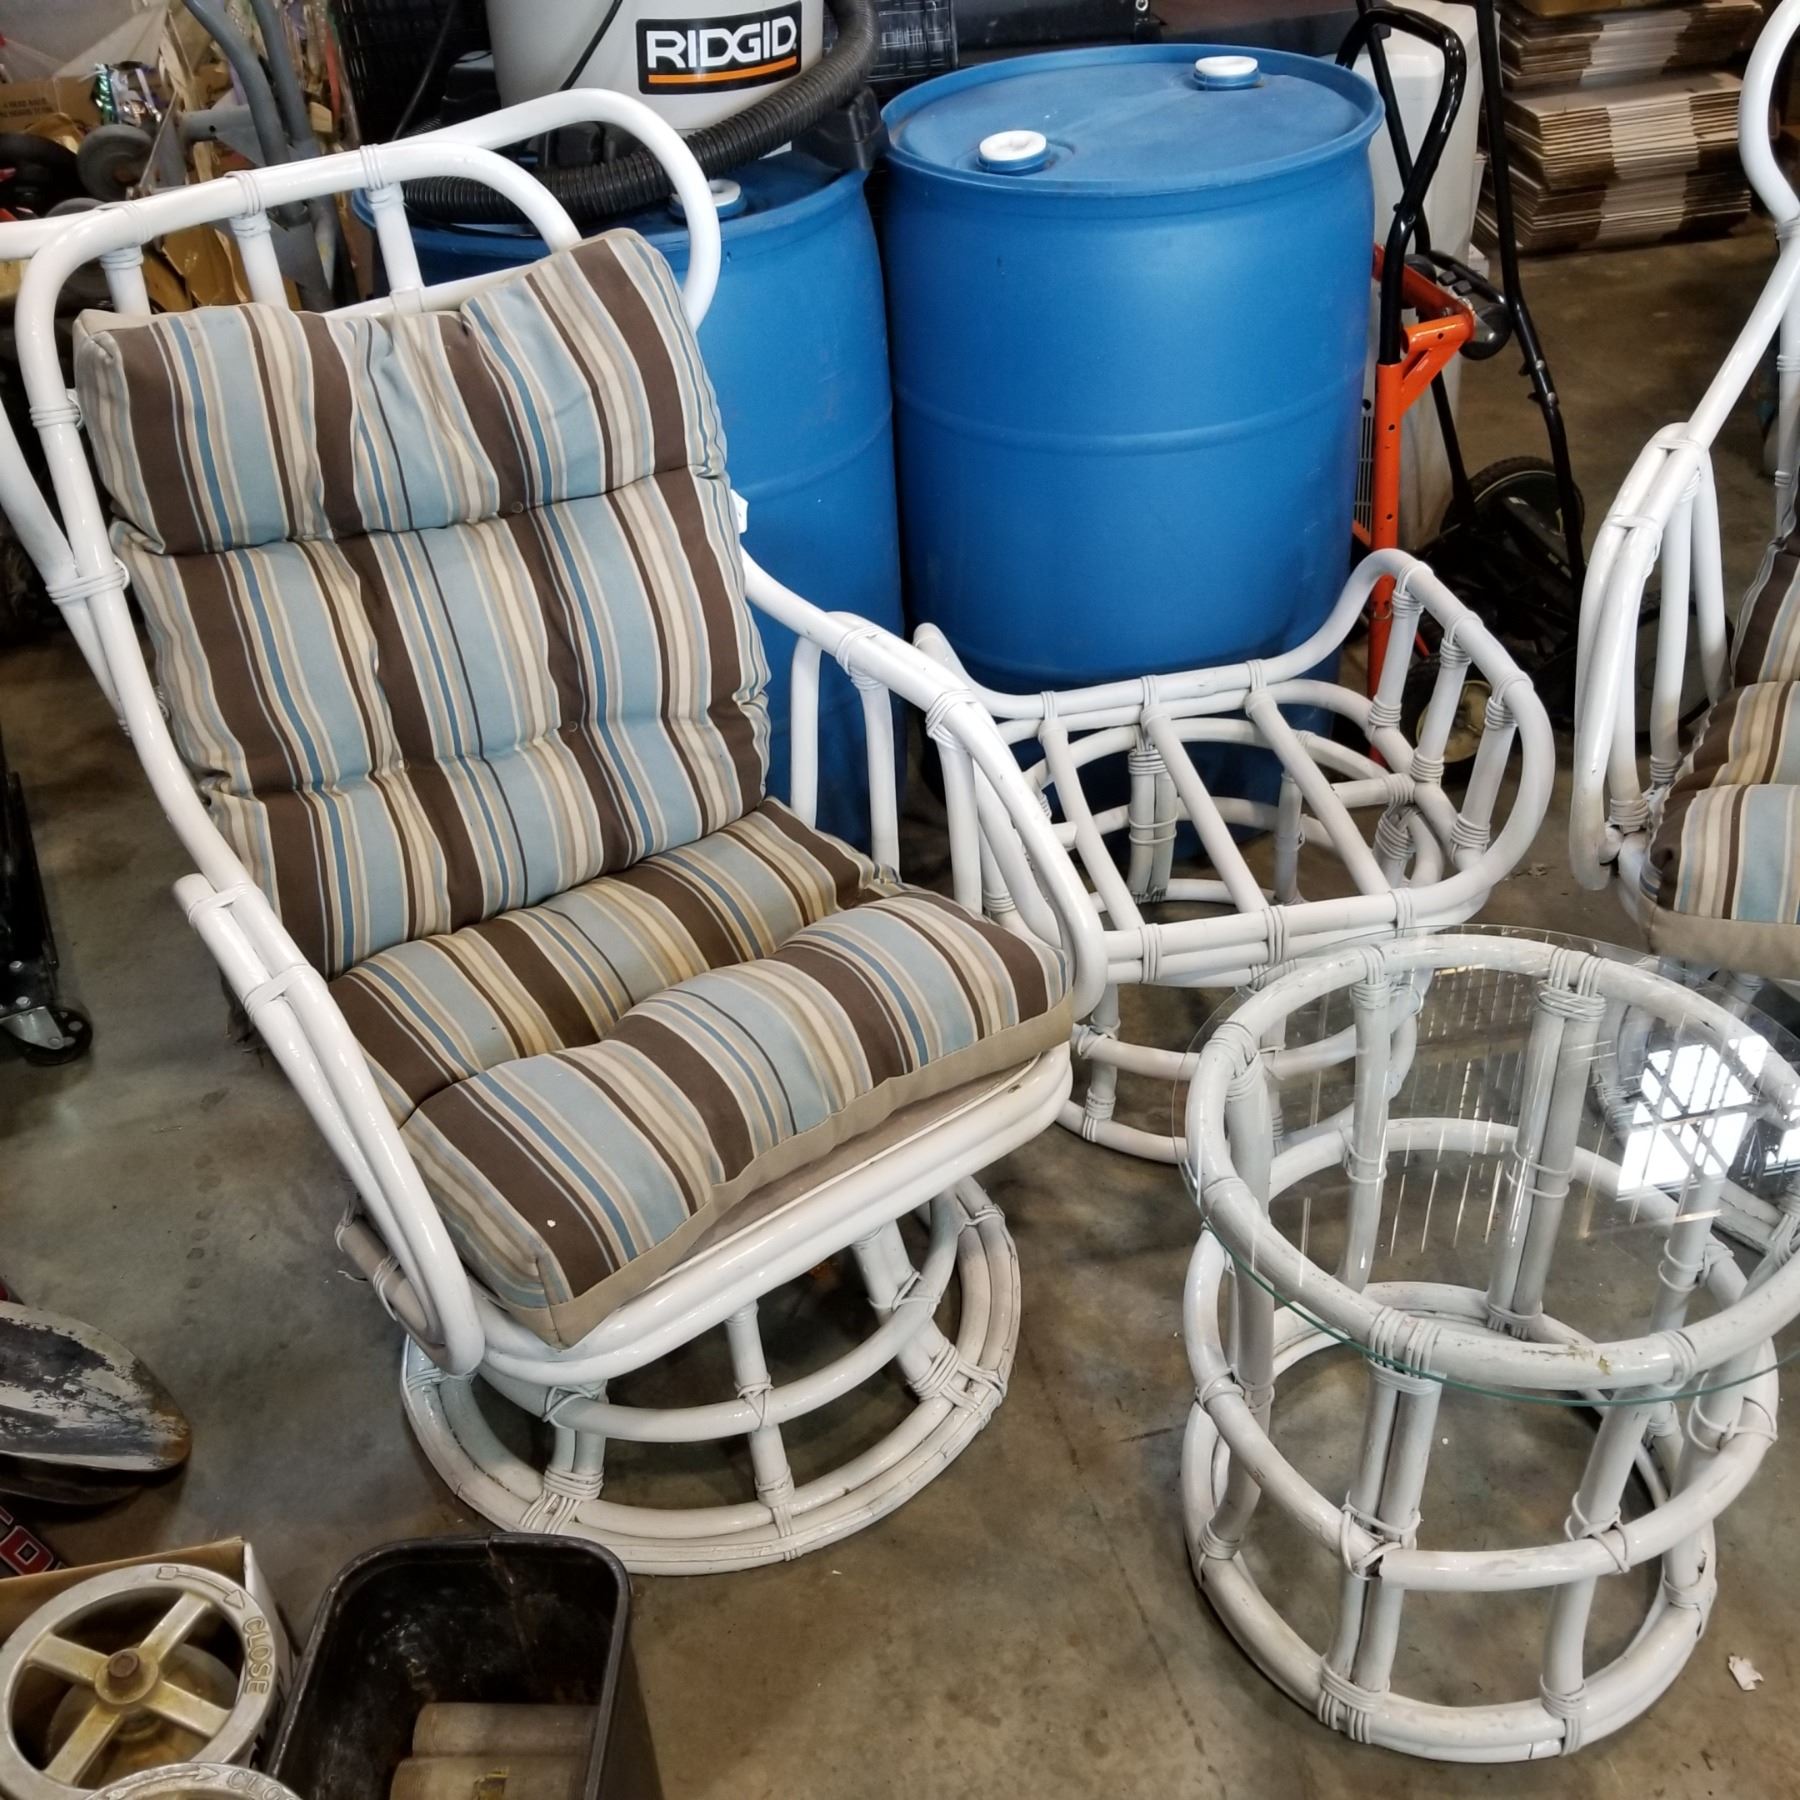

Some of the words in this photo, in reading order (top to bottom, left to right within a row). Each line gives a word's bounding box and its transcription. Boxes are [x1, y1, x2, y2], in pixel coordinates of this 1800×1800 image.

[646, 16, 797, 68] RIDGID
[242, 1616, 273, 1695] CLOSE
[226, 1768, 298, 1800] CLO
